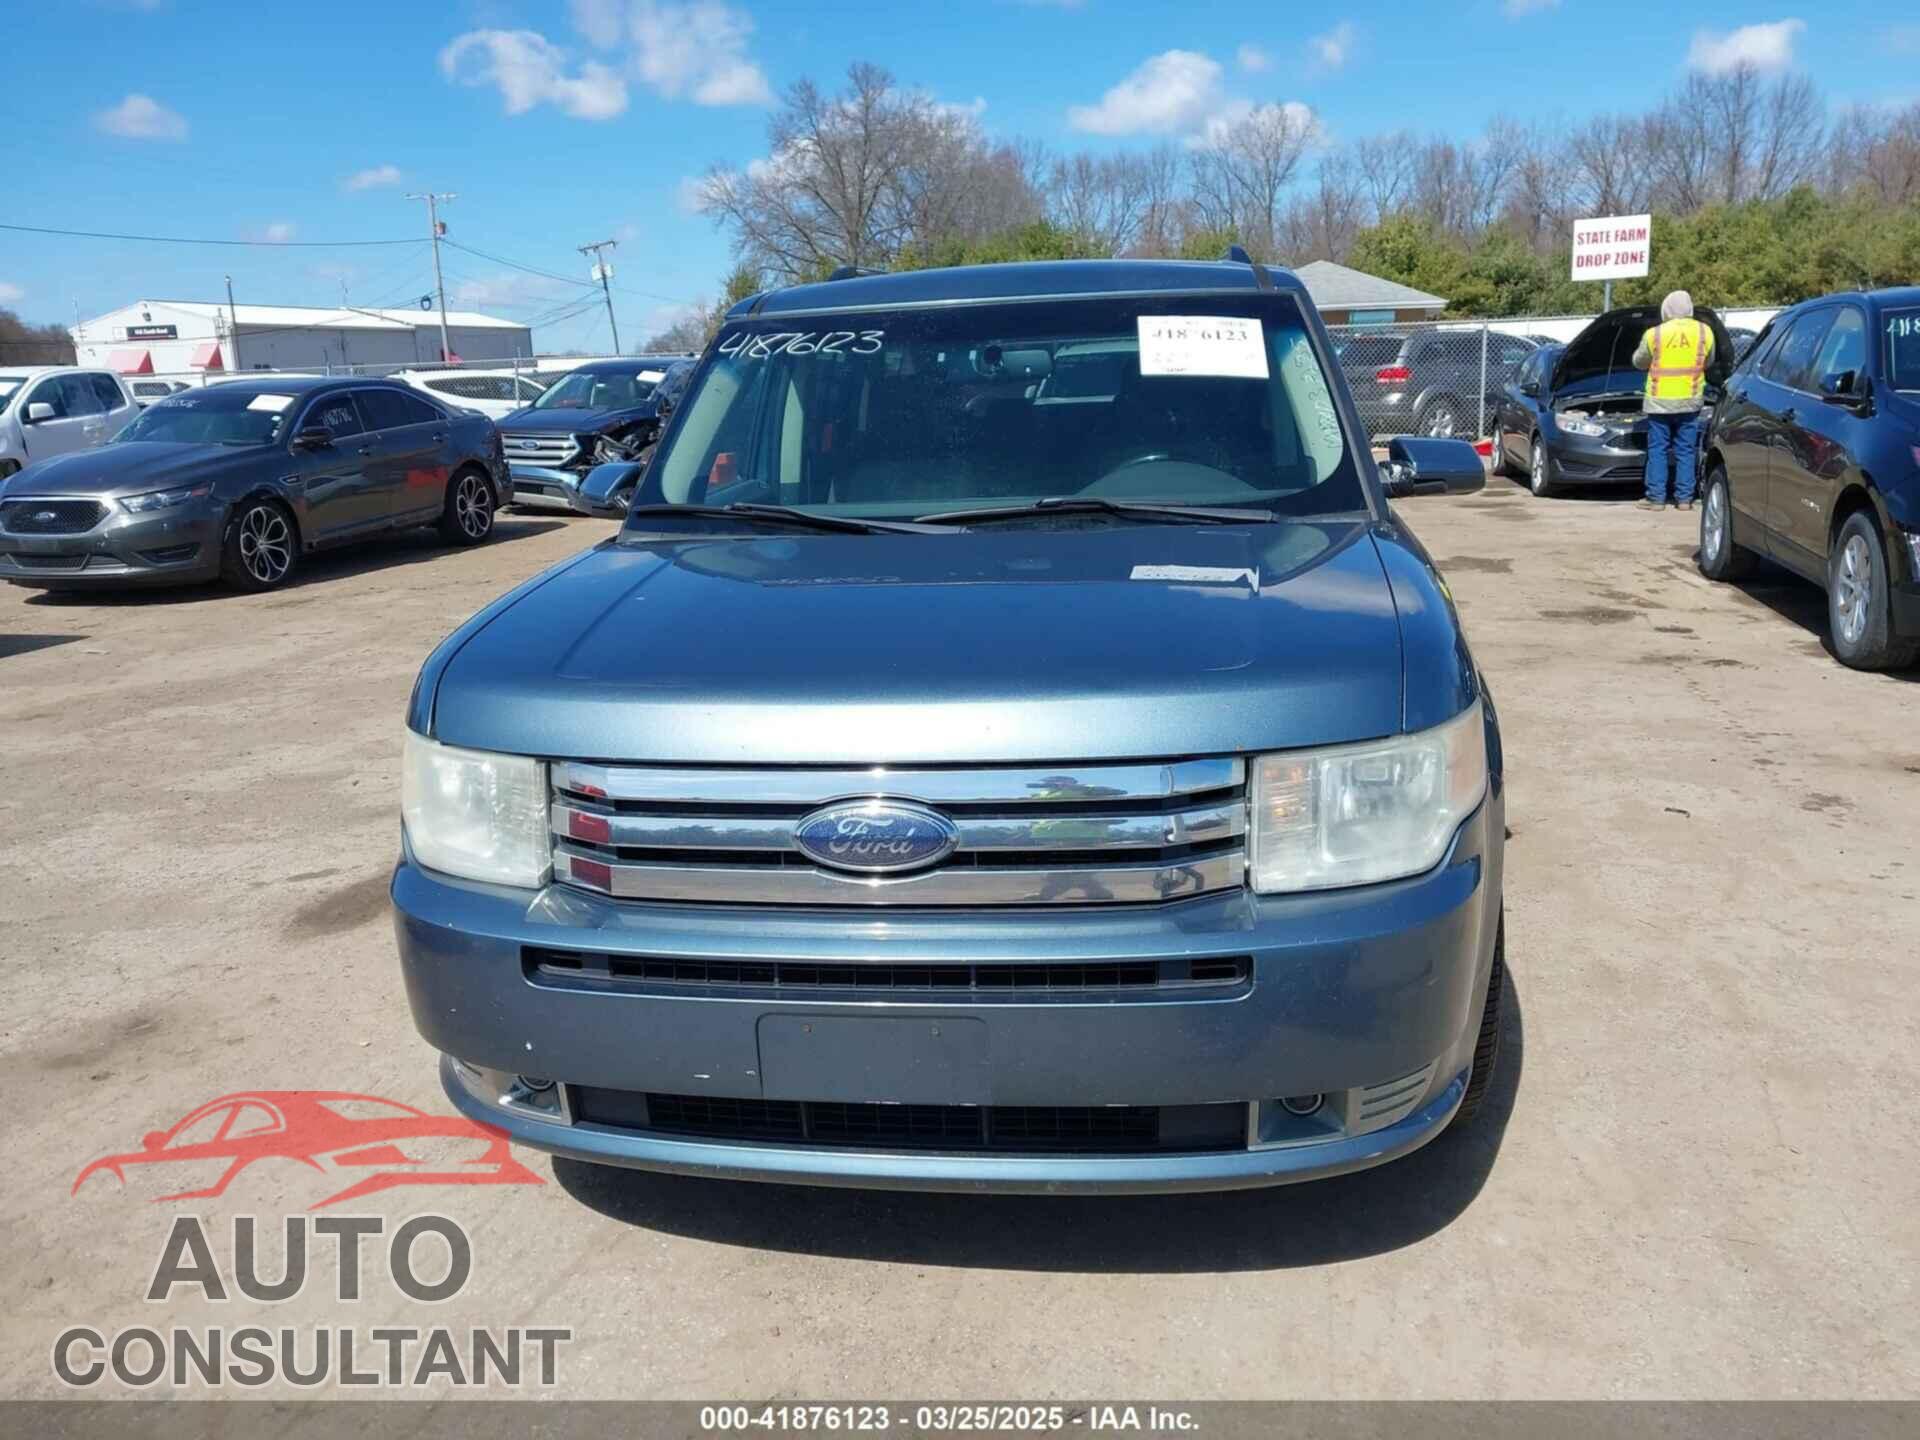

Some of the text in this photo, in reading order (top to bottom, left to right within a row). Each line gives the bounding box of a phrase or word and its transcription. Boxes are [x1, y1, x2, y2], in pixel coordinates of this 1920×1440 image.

[1577, 227, 1647, 246] STATE FARM
[1576, 250, 1647, 268] DROP ZONE
[718, 330, 884, 360] 41876123
[829, 817, 916, 853] Ford
